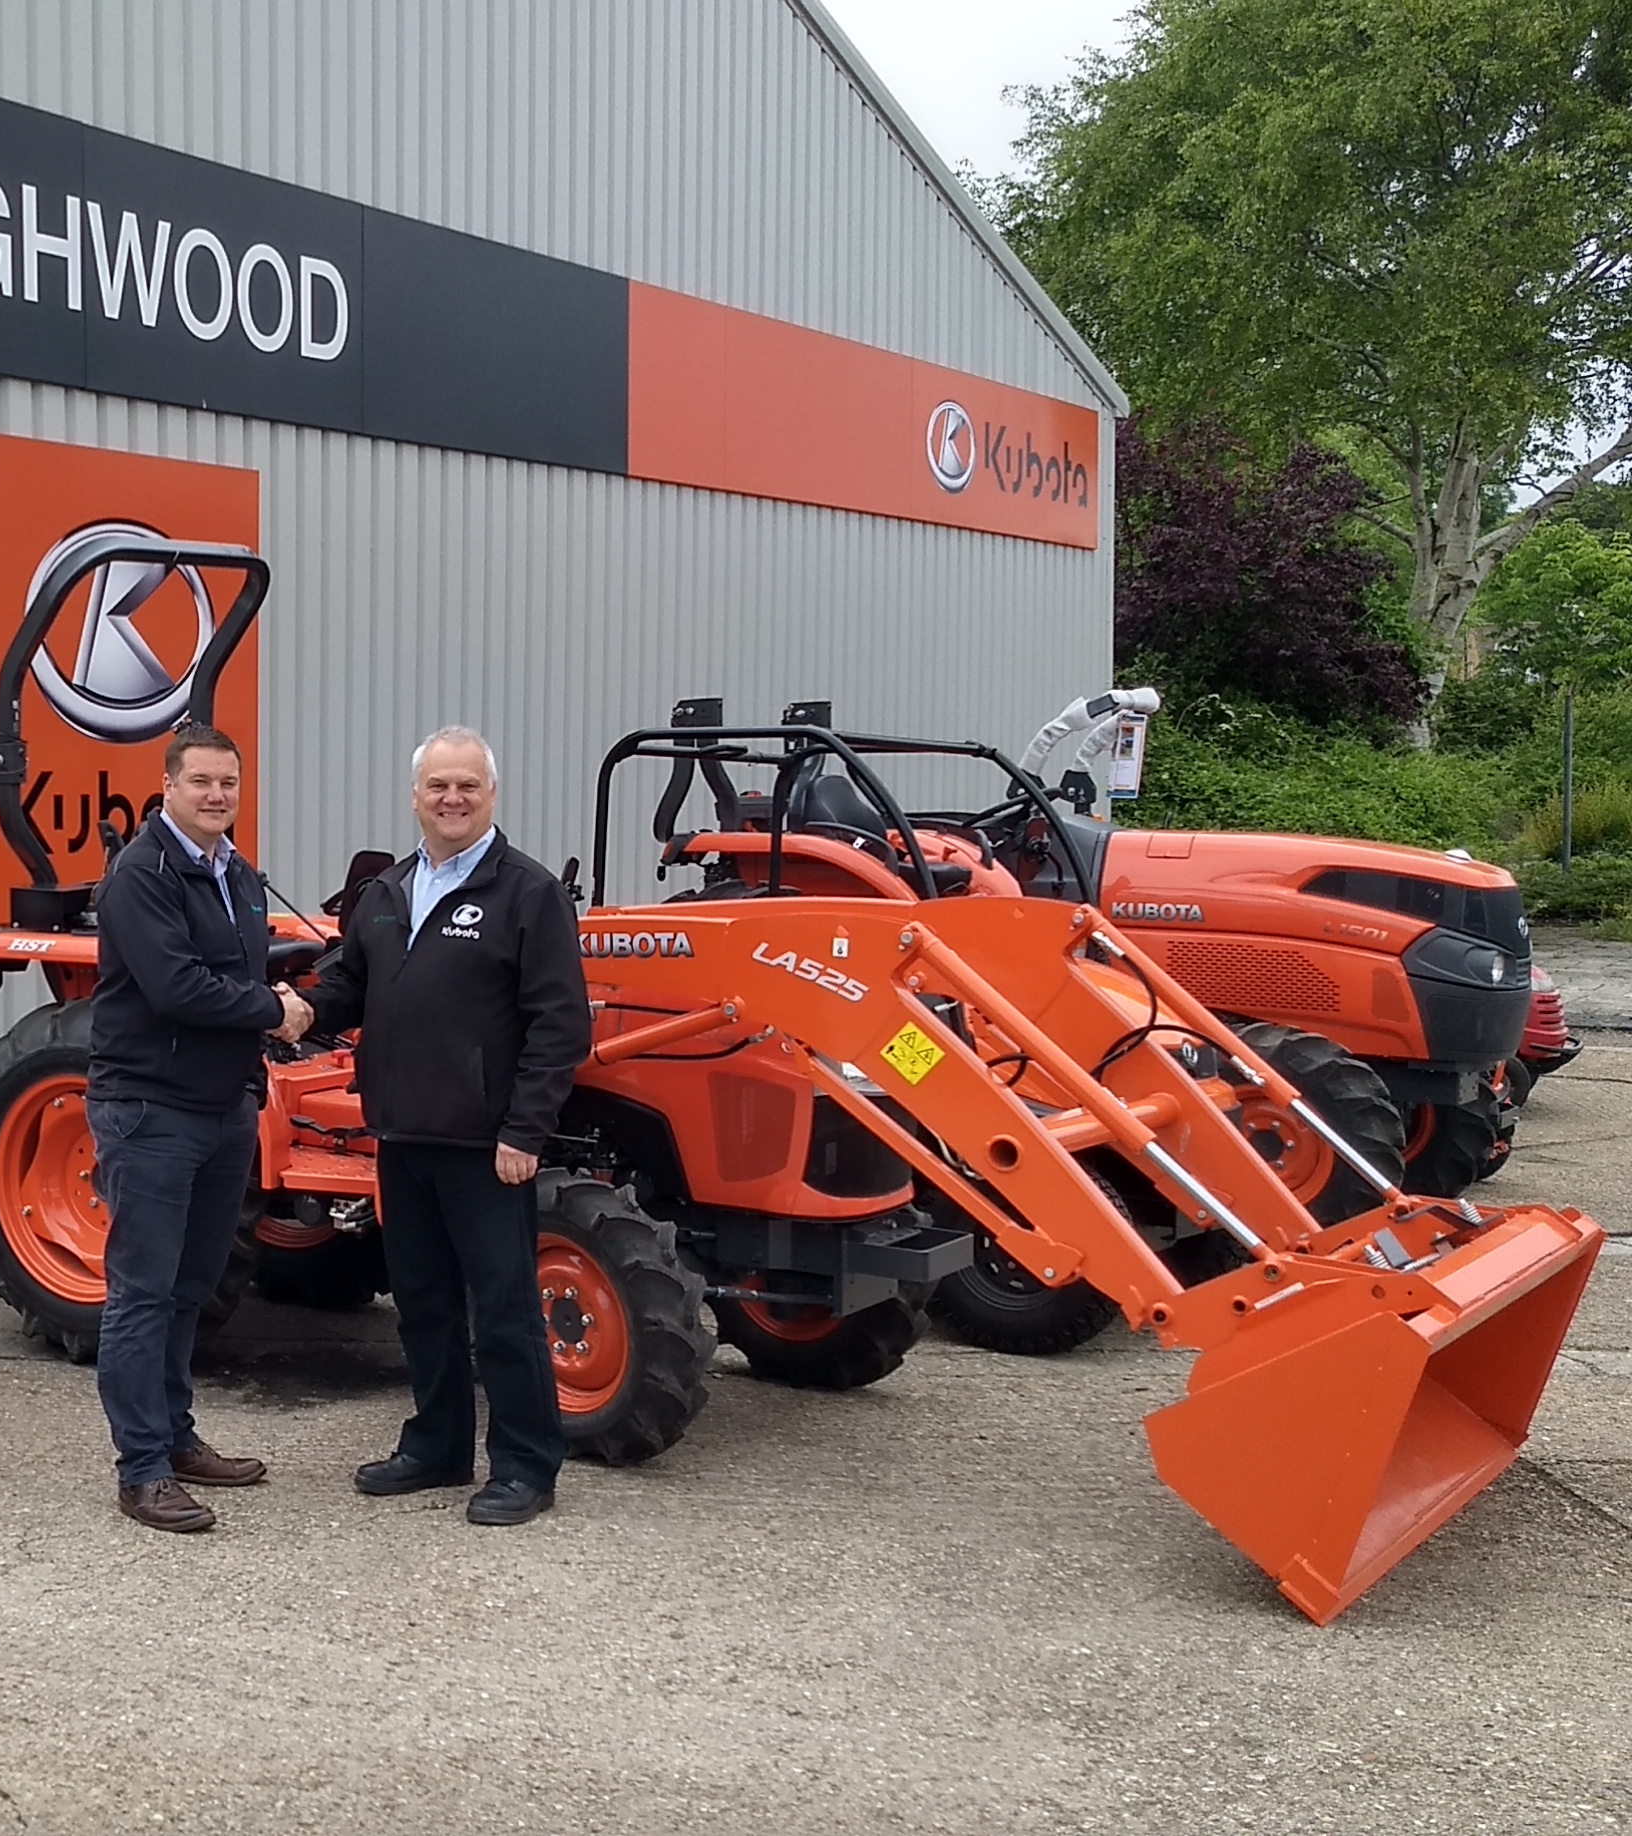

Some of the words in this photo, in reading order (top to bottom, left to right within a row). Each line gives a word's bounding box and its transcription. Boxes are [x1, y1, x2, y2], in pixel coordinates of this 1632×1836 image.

[983, 421, 1088, 508] Kubota
[1111, 901, 1204, 923] KUBOTA
[441, 925, 481, 940] Kubota
[577, 931, 695, 958] KUBOTA
[7, 937, 56, 953] HST
[751, 941, 870, 1004] LA525
